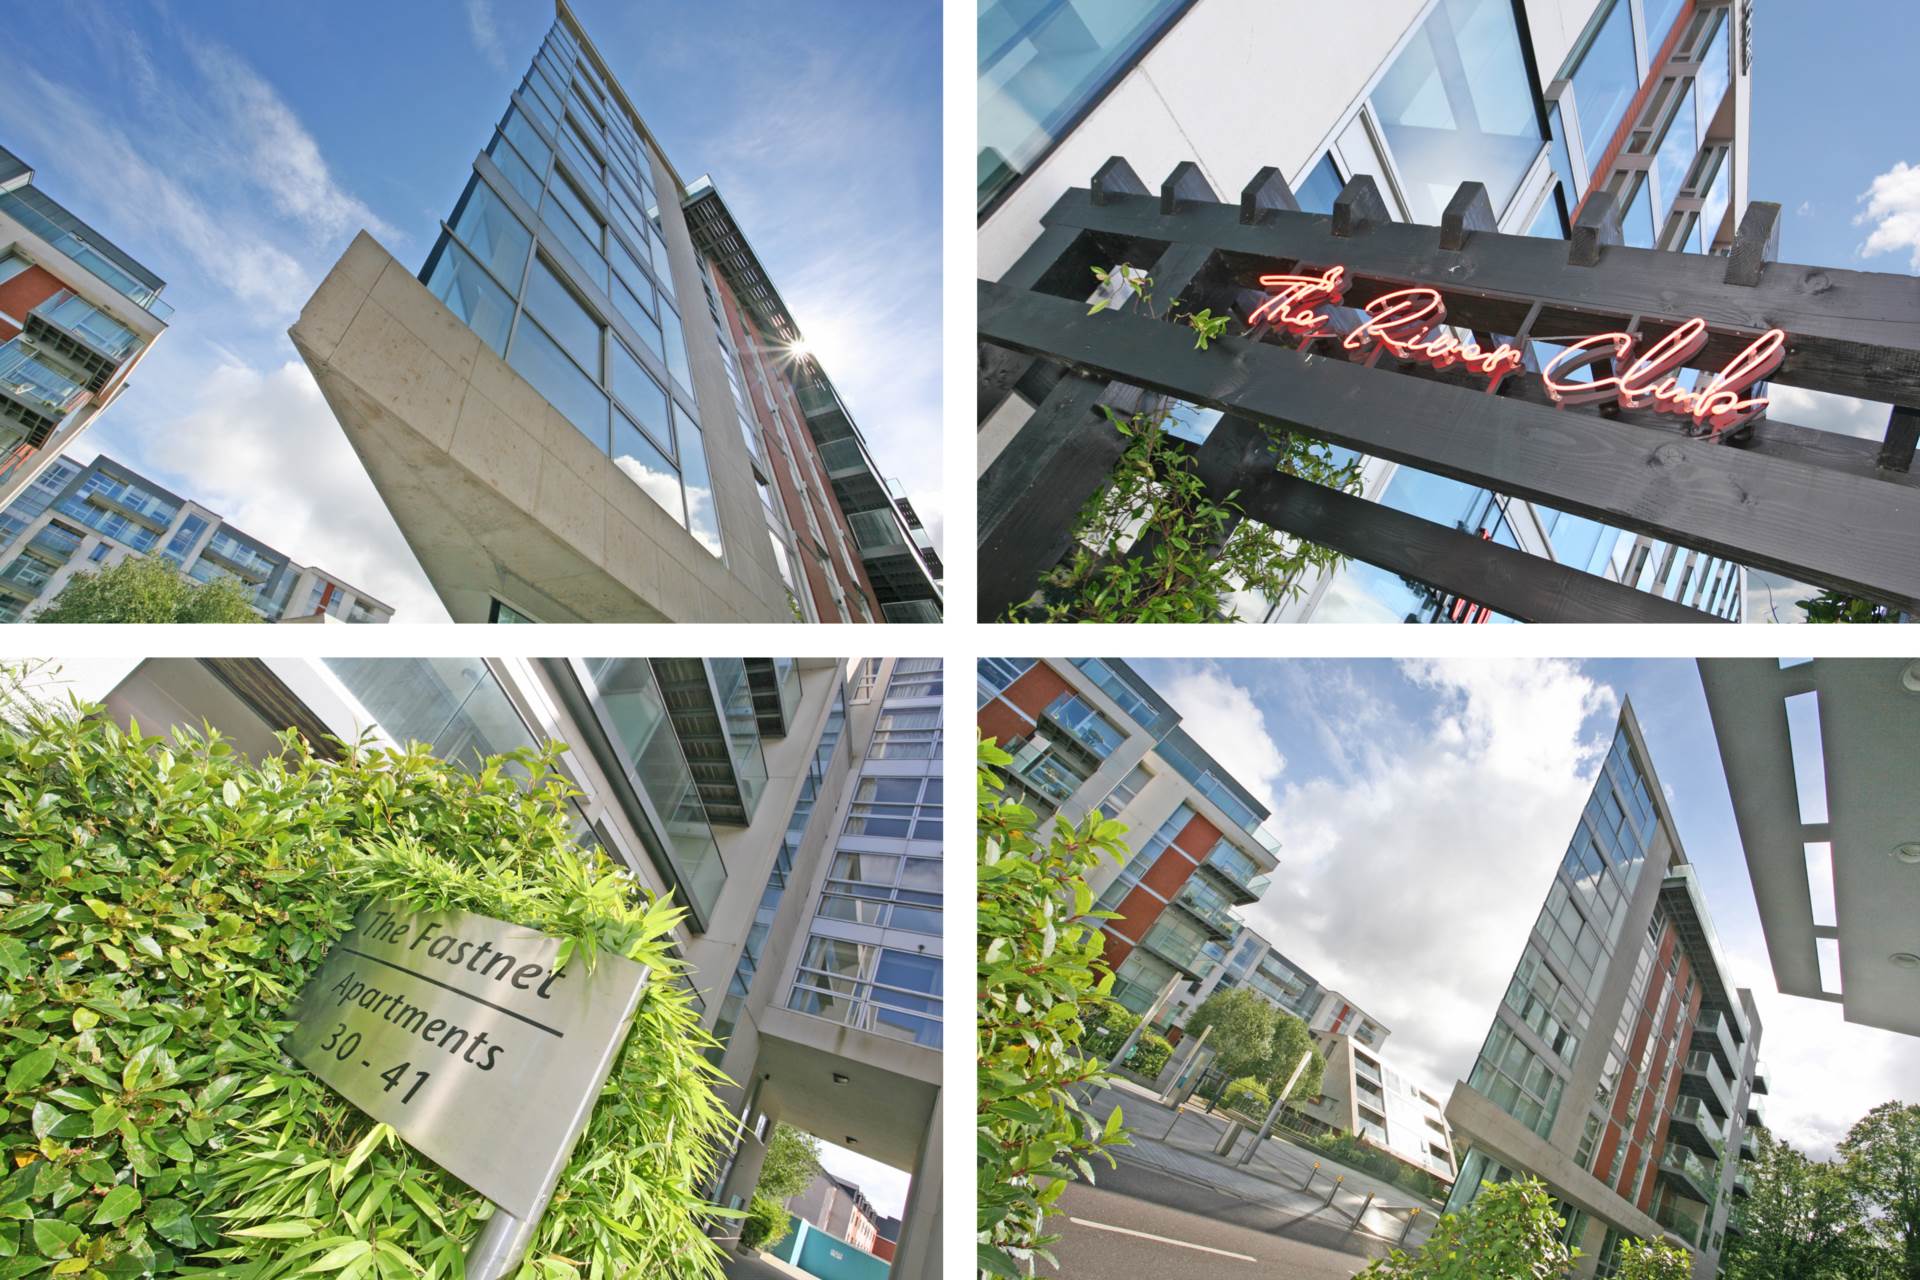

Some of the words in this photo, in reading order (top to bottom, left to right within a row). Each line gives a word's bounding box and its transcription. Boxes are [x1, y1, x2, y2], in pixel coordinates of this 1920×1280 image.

[1248, 266, 1344, 326] The
[1343, 287, 1521, 373] River
[1542, 316, 1785, 417] Club
[362, 910, 410, 945] The
[408, 922, 567, 999] Fastnet
[321, 1023, 362, 1061] 30
[380, 1061, 431, 1105] 41
[331, 971, 505, 1071] Apartments
